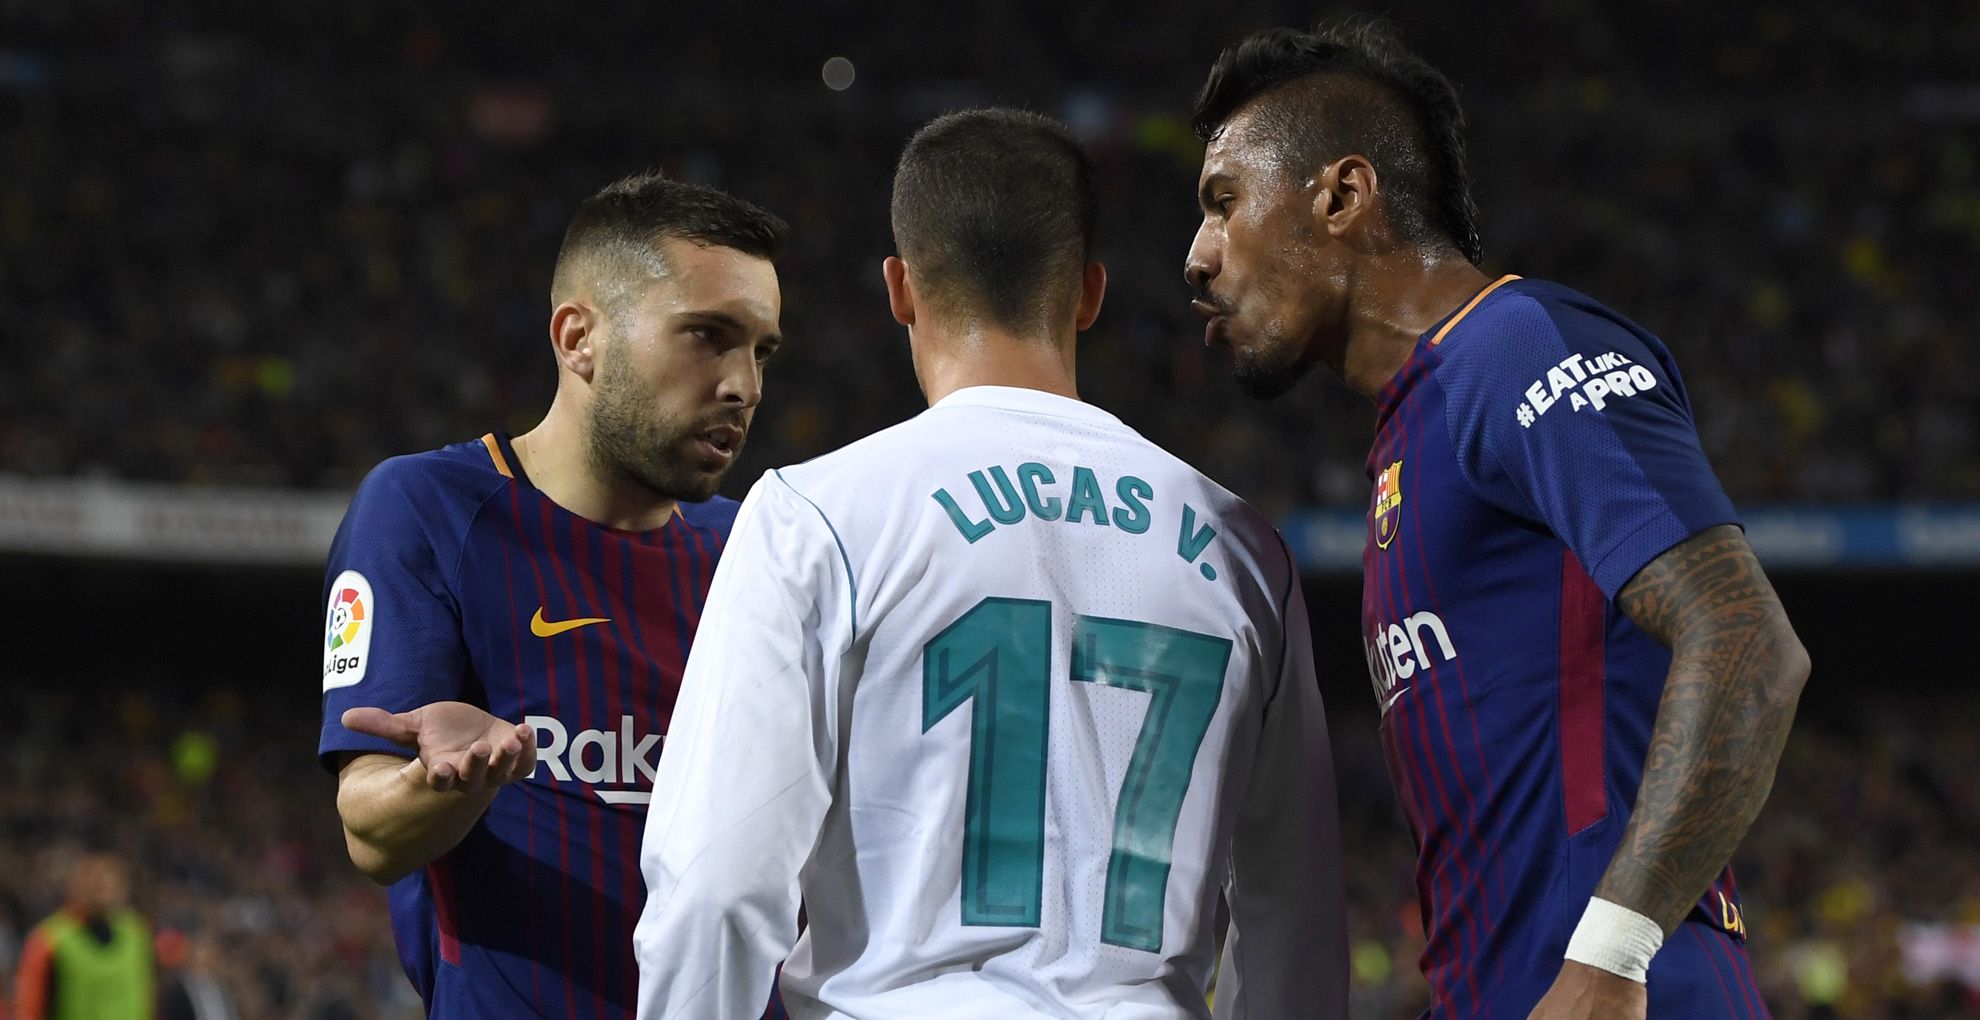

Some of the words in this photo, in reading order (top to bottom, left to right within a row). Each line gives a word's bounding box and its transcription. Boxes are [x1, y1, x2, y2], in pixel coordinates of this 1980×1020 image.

[1516, 353, 1587, 428] #EAT
[1570, 392, 1589, 412] A
[1582, 365, 1657, 411] PRO
[931, 462, 1154, 545] LUCAS
[1177, 503, 1217, 581] V.
[525, 715, 667, 785] Rak
[922, 596, 1233, 954] 17
